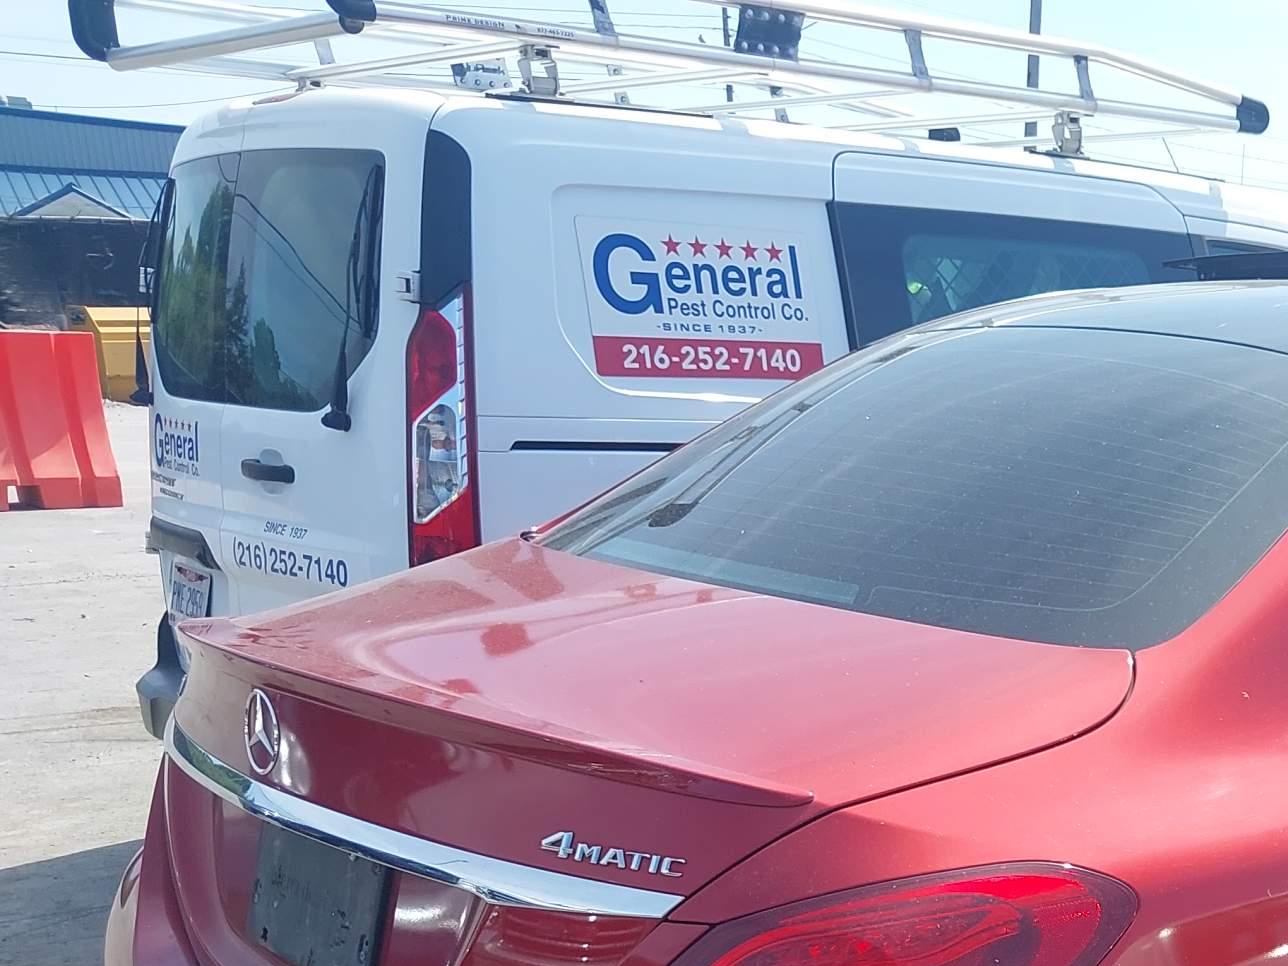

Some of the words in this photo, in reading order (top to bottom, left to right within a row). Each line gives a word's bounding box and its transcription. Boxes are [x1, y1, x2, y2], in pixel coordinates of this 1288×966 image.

[593, 233, 803, 315] General
[667, 298, 707, 318] Pest
[712, 300, 776, 320] Control
[781, 303, 809, 321] Co.
[622, 344, 801, 373] 216-252-7140
[155, 413, 199, 467] General
[263, 521, 287, 536] SINCE
[289, 527, 308, 540] 1937
[540, 831, 687, 877] 4MATIC
